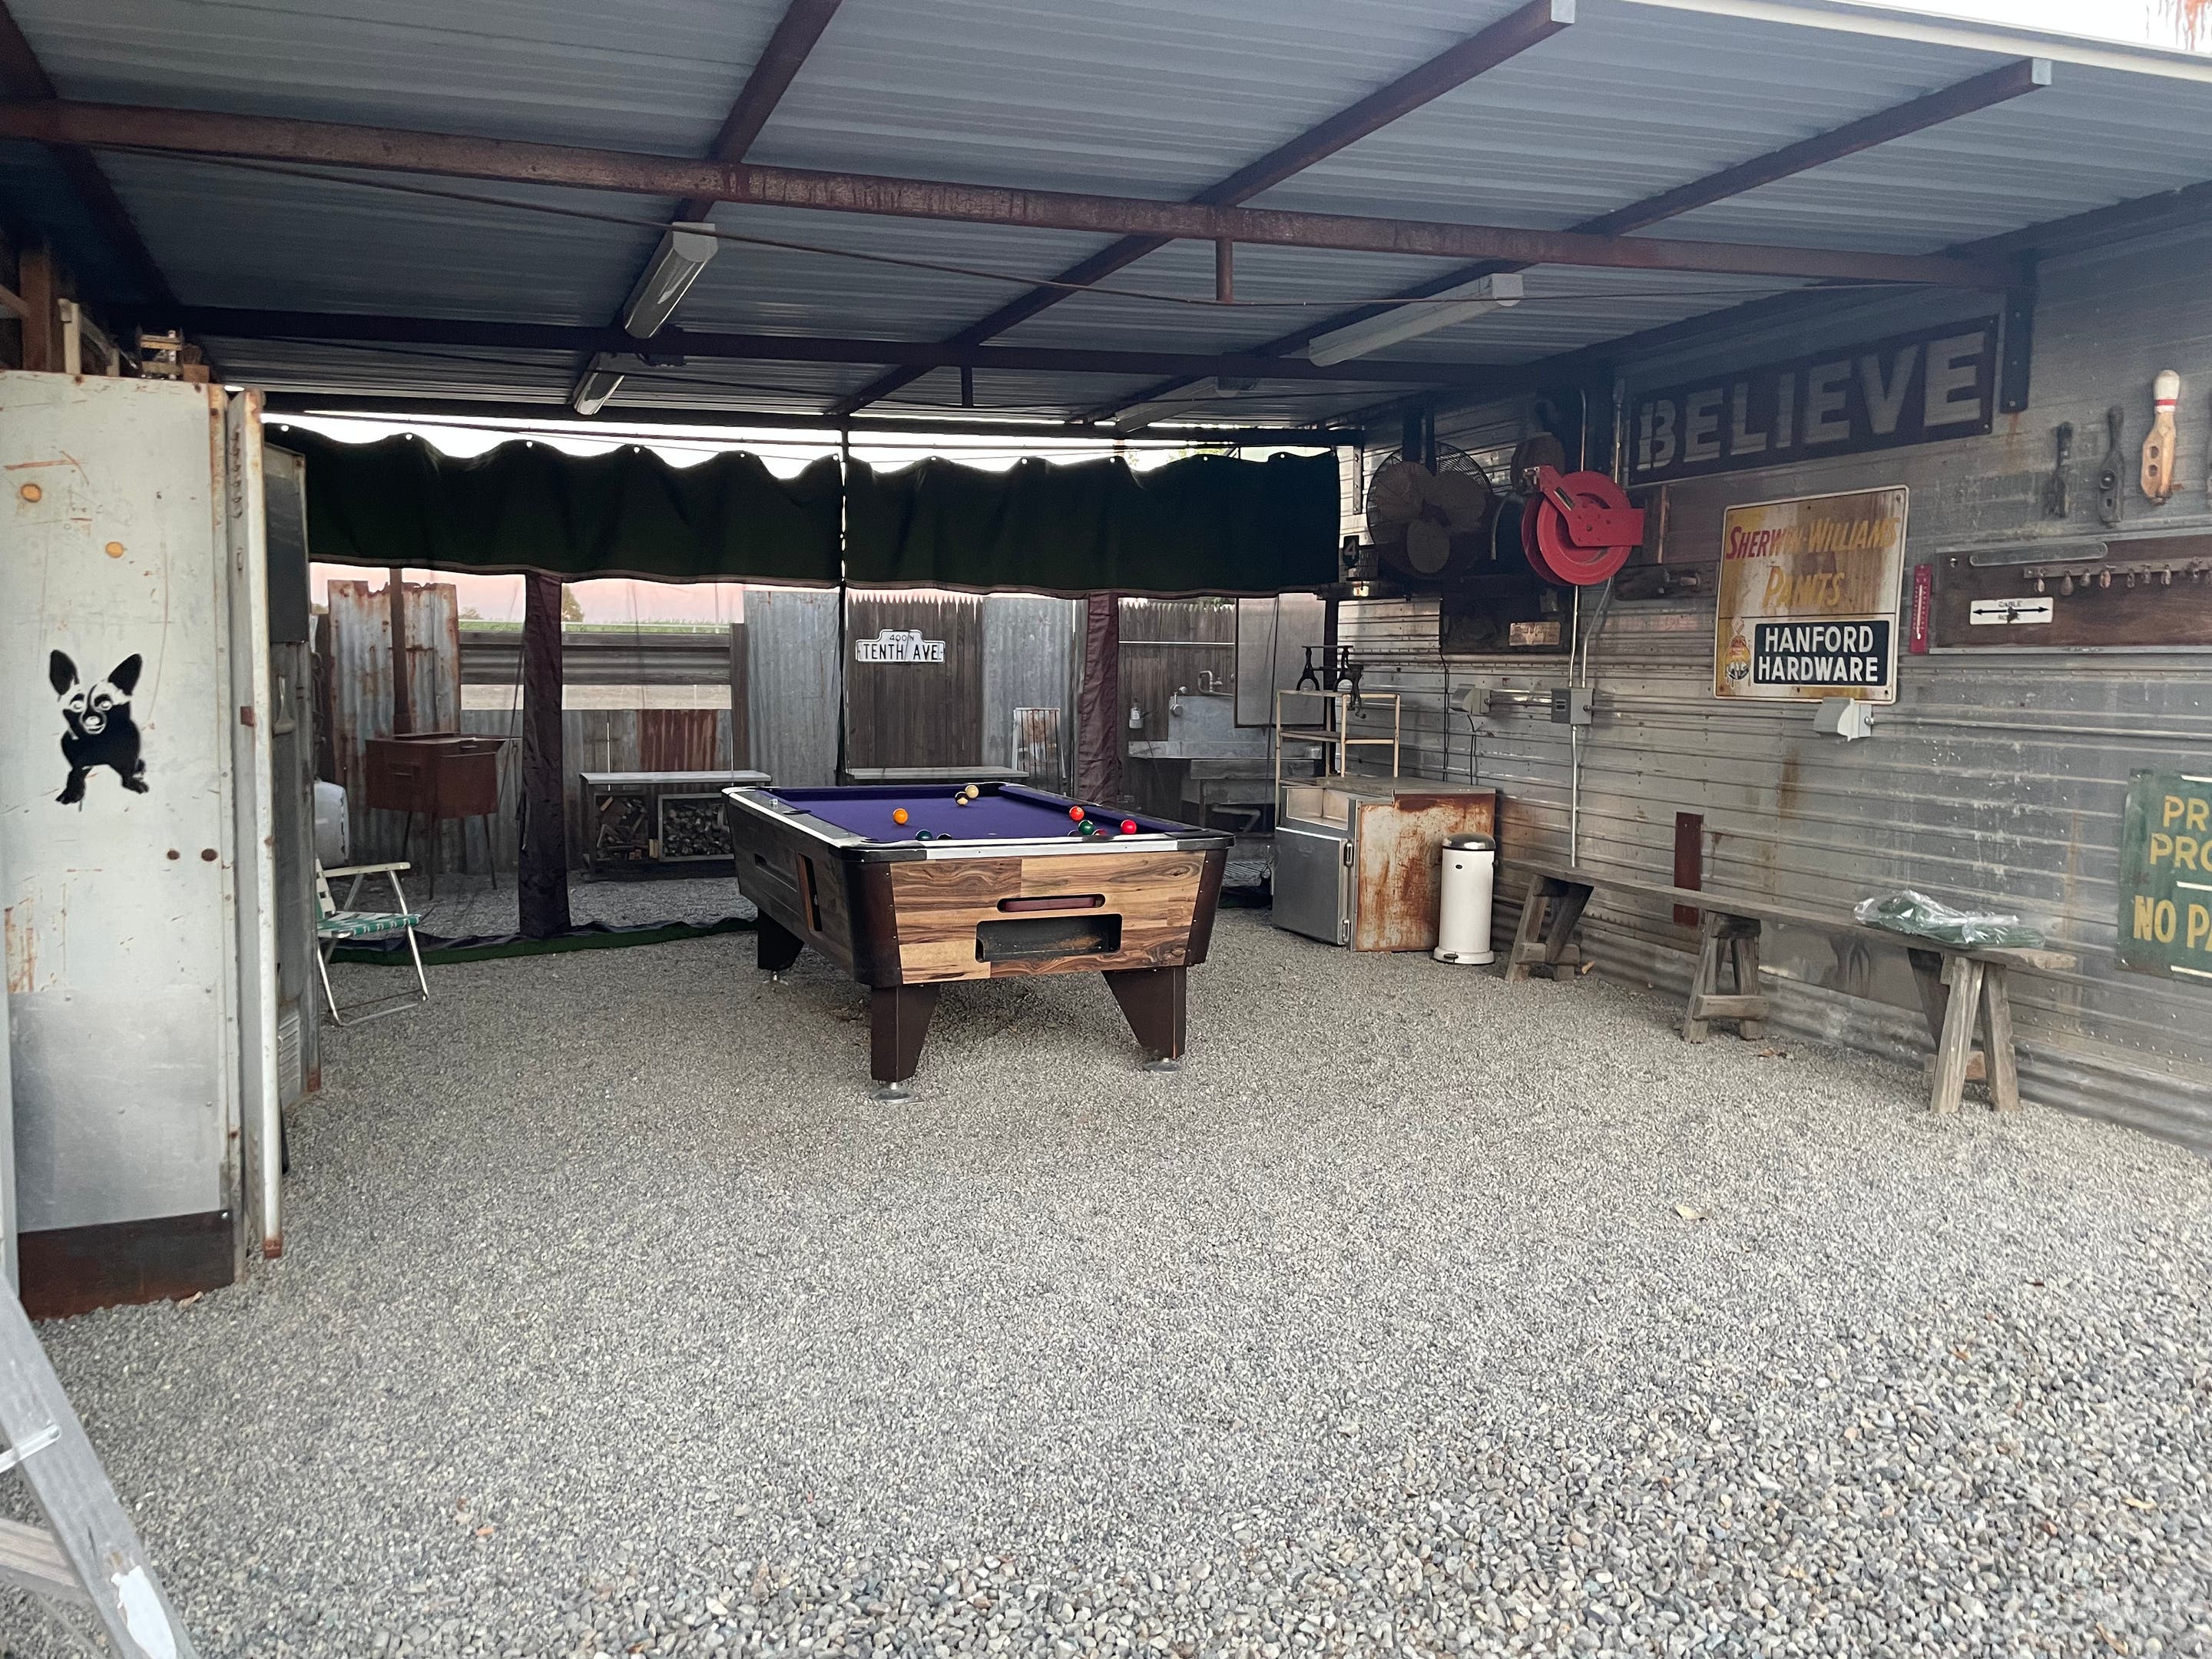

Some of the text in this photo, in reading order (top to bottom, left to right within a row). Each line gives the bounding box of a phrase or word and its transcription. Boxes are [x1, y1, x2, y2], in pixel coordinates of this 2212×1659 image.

[1637, 332, 1985, 472] BELIEVE
[1344, 540, 1356, 560] 4
[863, 644, 903, 660] TENTH
[1765, 625, 1874, 653] HANFORD
[1758, 656, 1878, 683] HARDWARE
[2133, 895, 2177, 944] NO
